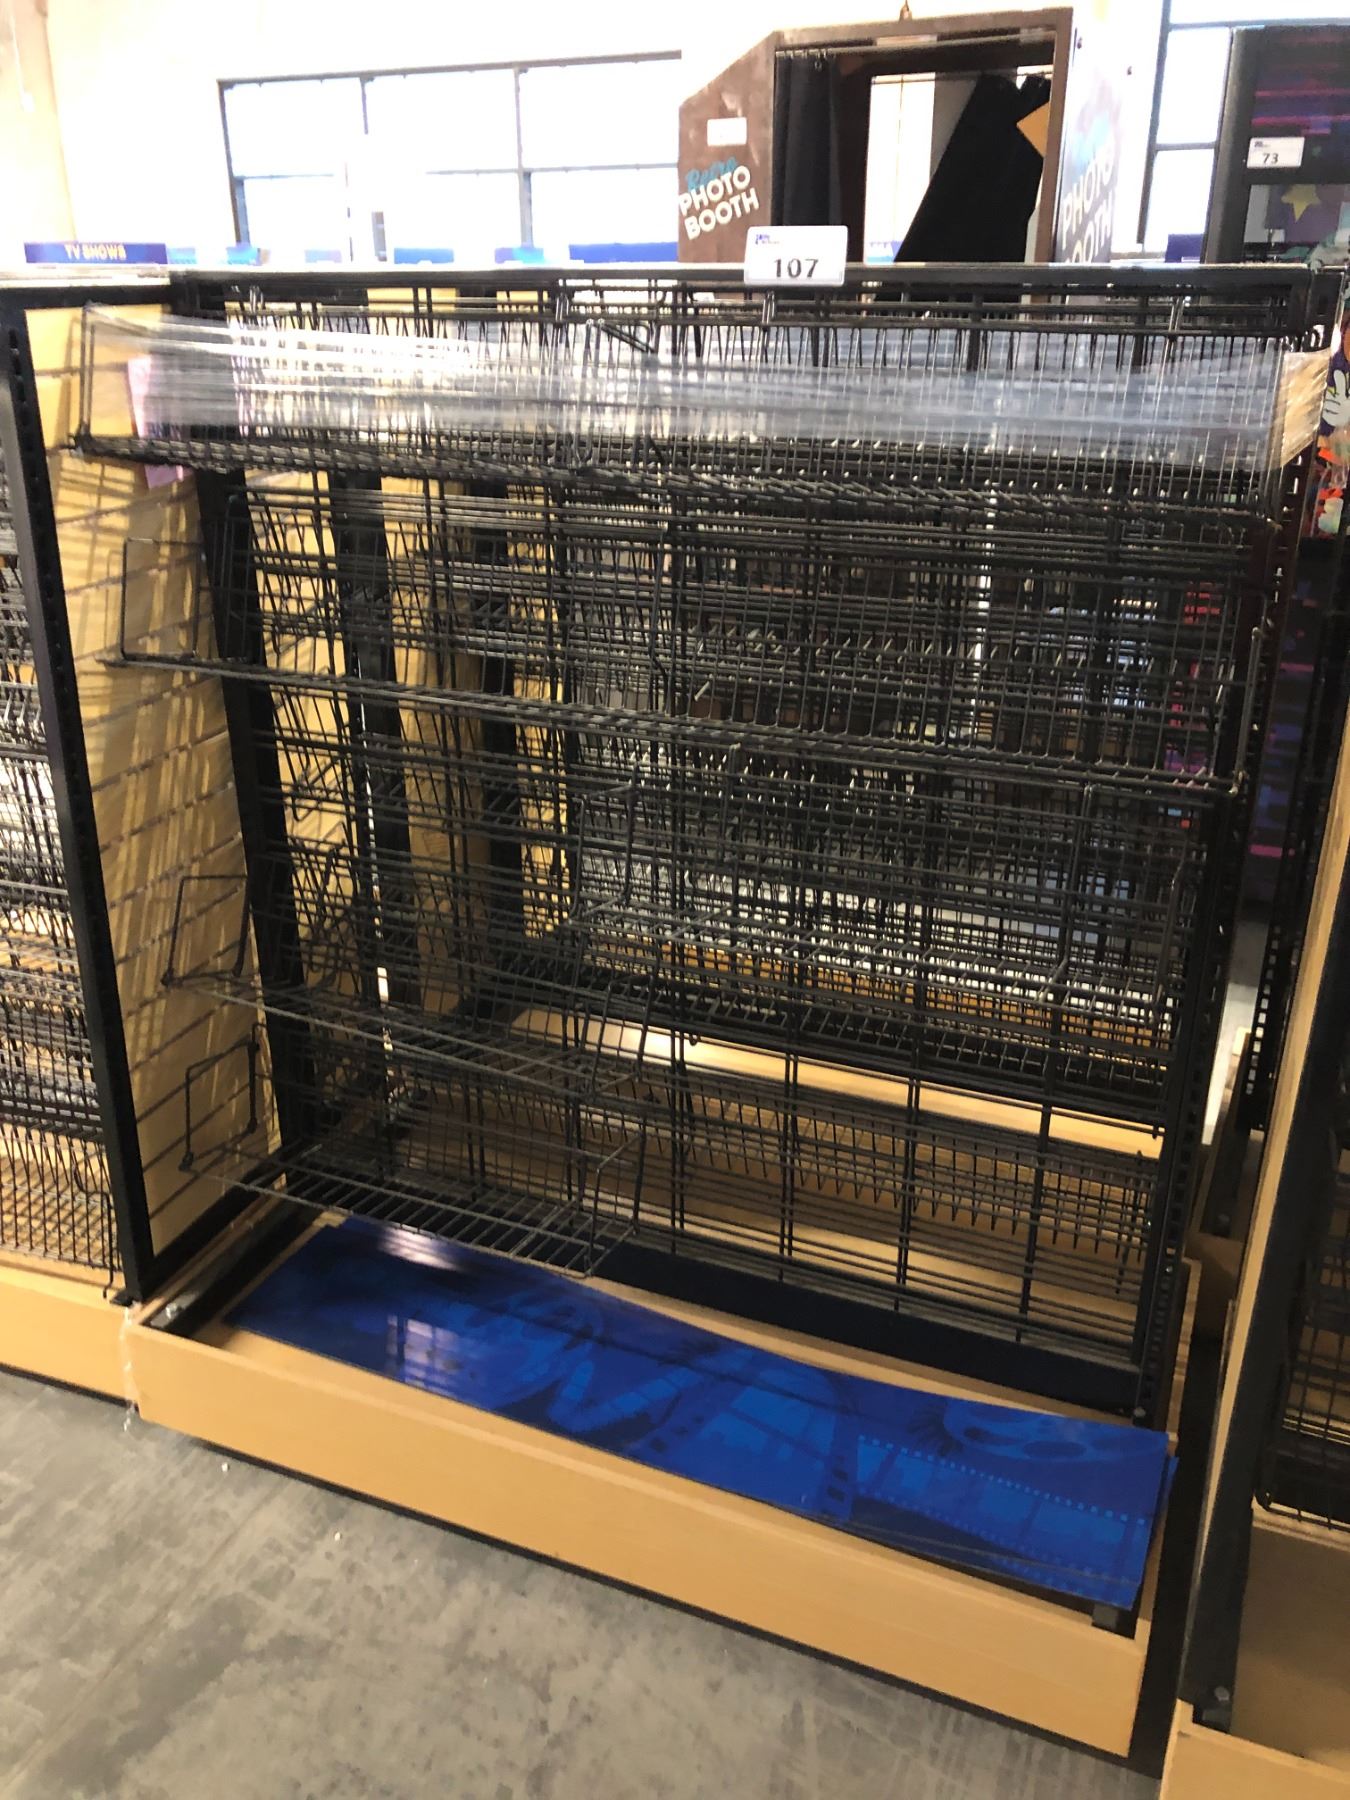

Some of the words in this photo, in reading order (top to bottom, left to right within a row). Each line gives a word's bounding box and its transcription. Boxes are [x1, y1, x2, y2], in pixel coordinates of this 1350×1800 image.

[1262, 153, 1279, 164] 73
[678, 165, 751, 216] PHOTO
[684, 188, 760, 240] BOOTH
[1062, 142, 1115, 251] PHOTO
[1065, 188, 1113, 262] OOTH
[64, 244, 80, 260] TV
[774, 258, 819, 278] 107
